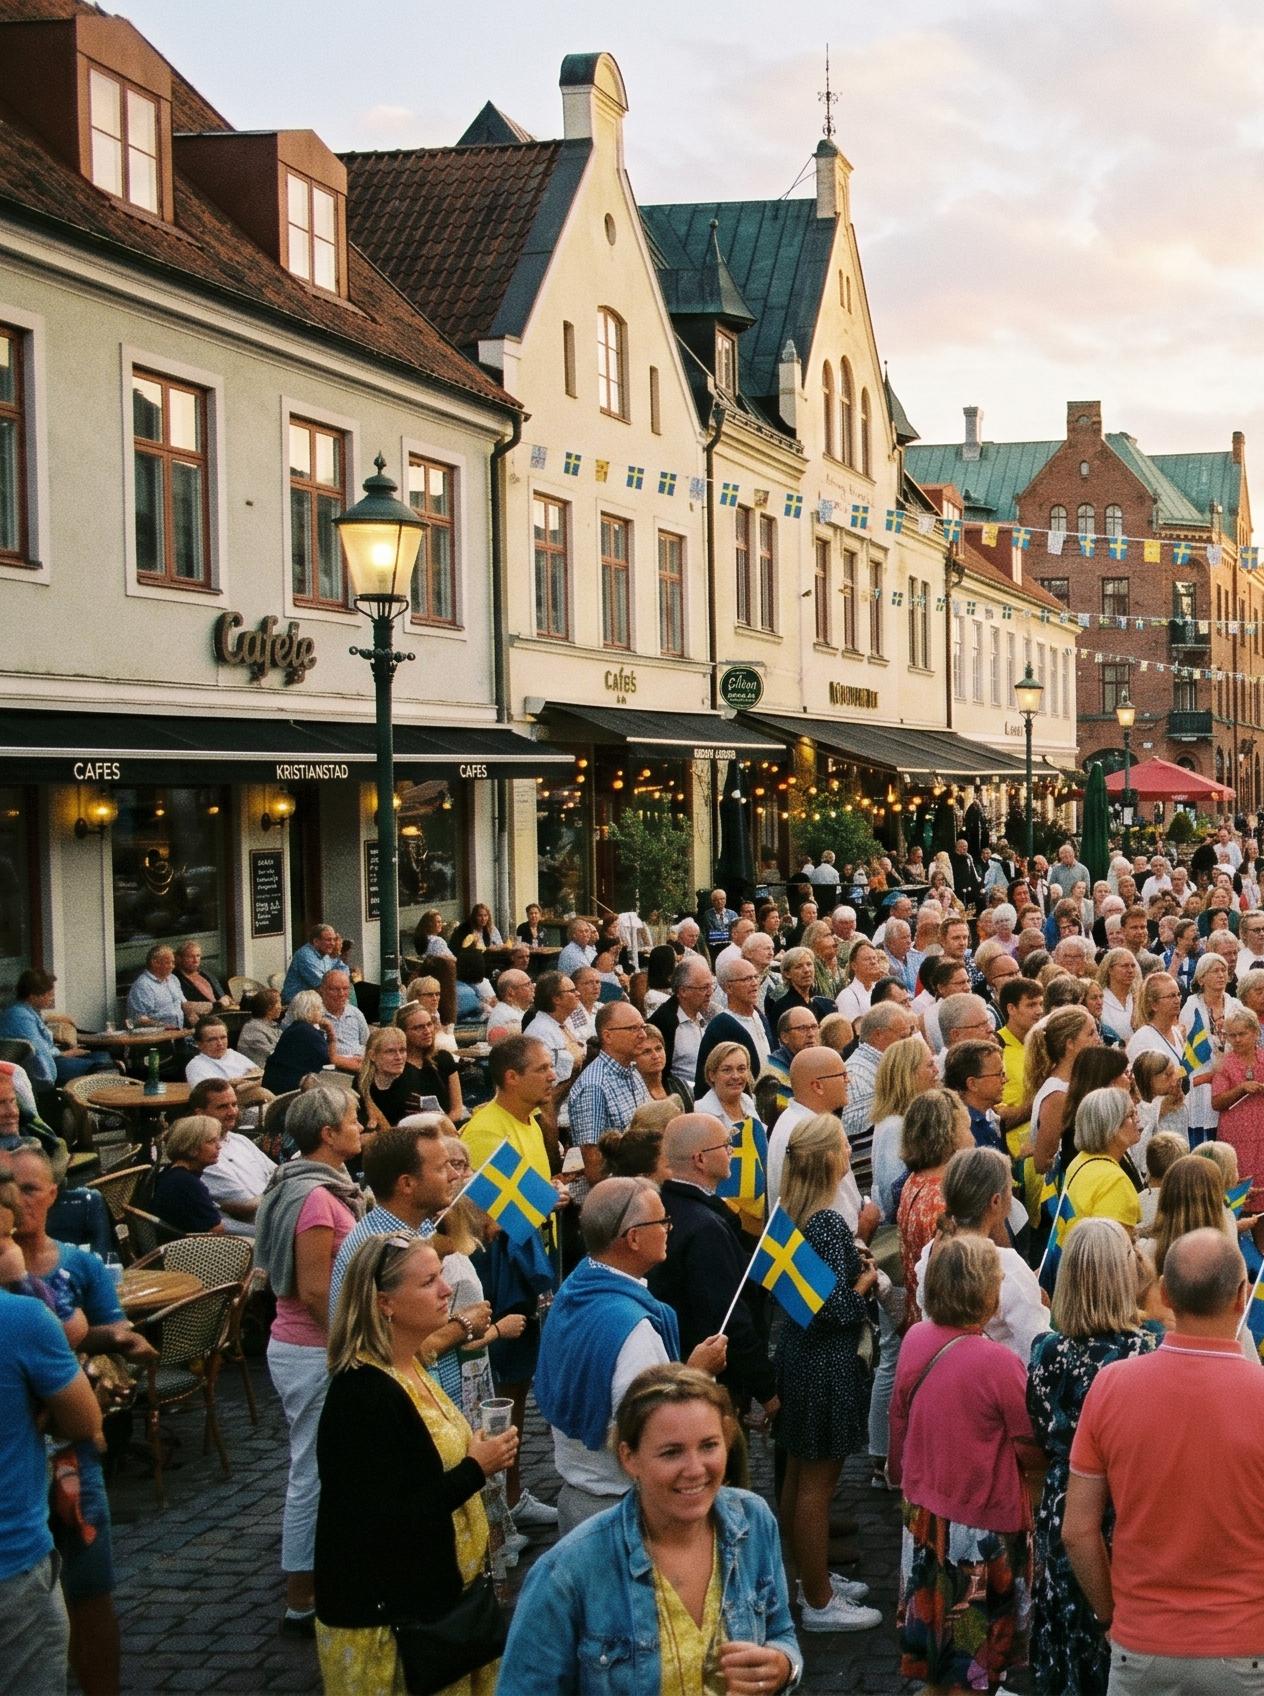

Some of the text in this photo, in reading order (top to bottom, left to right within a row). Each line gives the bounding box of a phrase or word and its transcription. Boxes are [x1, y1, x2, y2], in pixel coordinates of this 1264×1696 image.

[73, 762, 121, 780] CAFES
[276, 764, 349, 780] KRISTIANSTAD
[459, 764, 488, 778] CAFES
